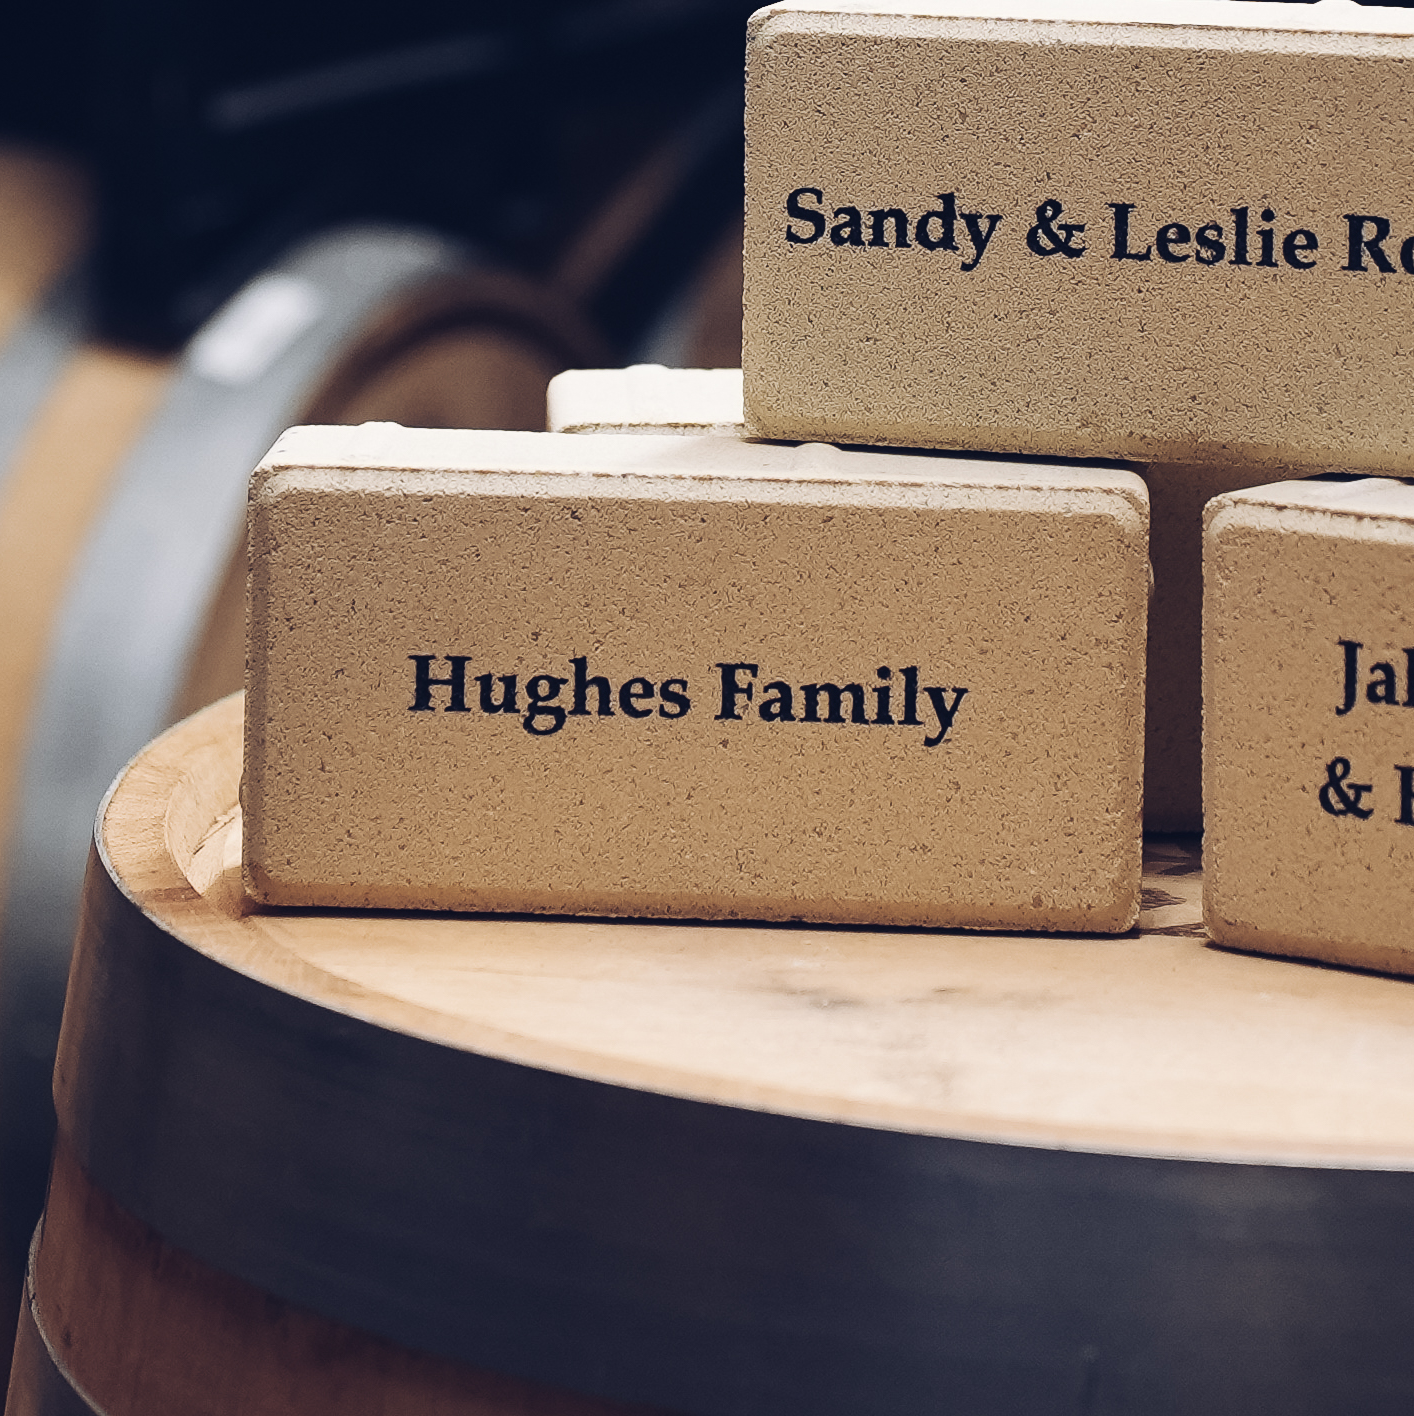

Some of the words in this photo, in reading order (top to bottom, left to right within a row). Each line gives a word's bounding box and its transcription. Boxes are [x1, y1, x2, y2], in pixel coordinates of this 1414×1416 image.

[786, 186, 1005, 272] Sandy
[1024, 198, 1088, 260] &
[1104, 201, 1319, 271] Leslie
[407, 654, 691, 736] Hughes
[714, 661, 969, 748] Family
[1318, 756, 1375, 821] &
